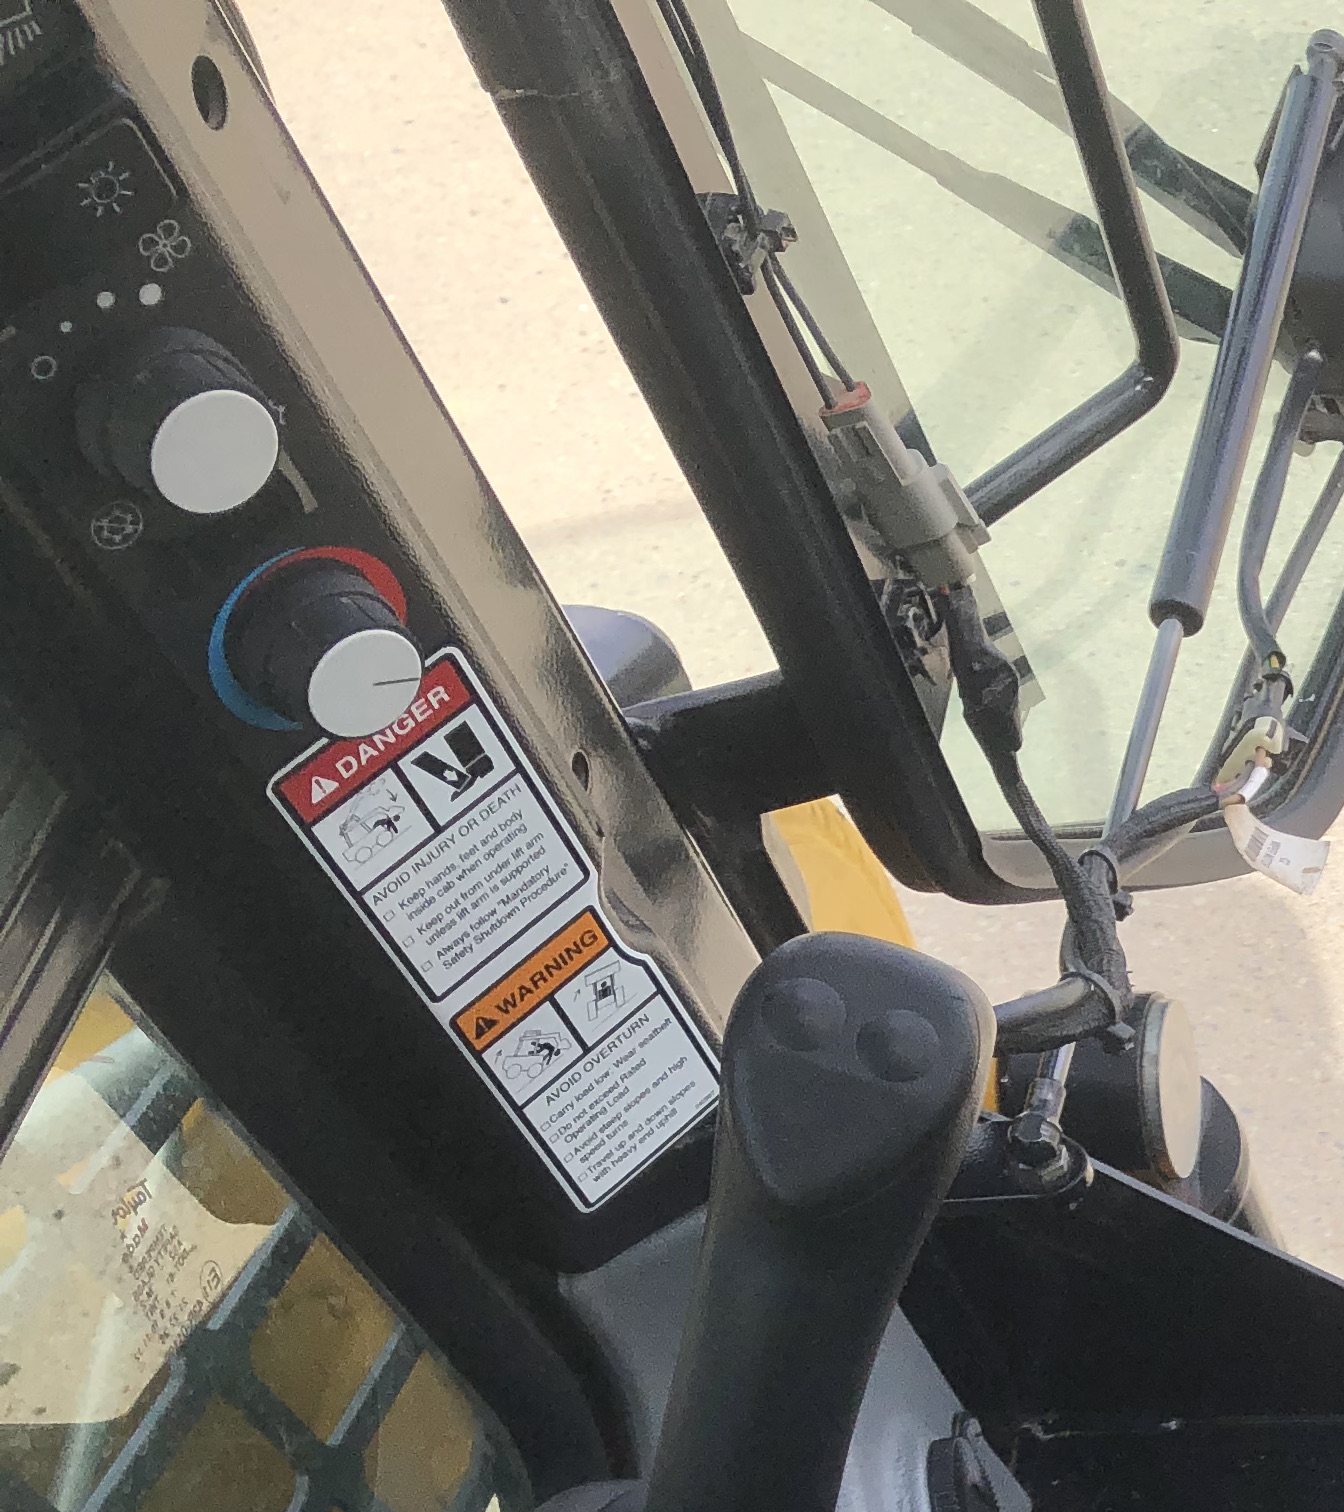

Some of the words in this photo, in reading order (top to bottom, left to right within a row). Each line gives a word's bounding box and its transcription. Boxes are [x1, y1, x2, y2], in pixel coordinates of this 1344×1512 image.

[335, 685, 451, 779] DANGER
[372, 871, 411, 907] AVOID
[411, 833, 456, 875] INJURY
[457, 817, 480, 838] OR
[478, 782, 522, 822] DEATH
[397, 887, 426, 911] Keep
[458, 843, 480, 863] feet
[479, 826, 499, 848] and
[497, 809, 523, 832] body
[405, 895, 437, 922] inside
[436, 880, 456, 898] cab
[455, 858, 483, 882] when
[482, 822, 528, 862] operating
[415, 912, 444, 936] Keep
[443, 897, 462, 915] out
[459, 880, 484, 902] from
[483, 857, 511, 884] under
[510, 846, 525, 861] lift
[525, 832, 545, 851] arm
[425, 918, 458, 946] unless
[455, 906, 471, 921] lift
[470, 891, 490, 911] arm
[488, 883, 500, 894] is
[499, 844, 547, 887] supported
[436, 930, 471, 961] Always
[469, 907, 498, 933] follow
[496, 864, 550, 907] "Mandatory
[442, 942, 474, 970] Safety
[472, 905, 521, 945] Shutdown
[493, 929, 599, 1017] WARNING
[545, 1071, 582, 1107] AVOID
[582, 1013, 650, 1073] OVERTURN
[548, 1100, 575, 1124] Carry
[573, 1082, 595, 1103] load
[612, 1047, 637, 1069] Wear
[637, 1017, 673, 1049] seatbelt
[557, 1122, 573, 1136] Do
[572, 1107, 589, 1124] not
[588, 1080, 621, 1111] exceed
[619, 1057, 647, 1084] Rated
[573, 1131, 599, 1156] Avoid
[598, 1111, 623, 1134] steep
[622, 1087, 651, 1114] slopes
[651, 1070, 669, 1089] and
[667, 1056, 688, 1074] high
[563, 1106, 609, 1144] Operating
[605, 1085, 631, 1108] Load
[579, 1137, 607, 1164] speed
[605, 1119, 629, 1141] turns
[586, 1148, 615, 1174] Travel
[614, 1140, 627, 1152] up
[627, 1123, 645, 1142] and
[644, 1104, 669, 1126] down
[667, 1080, 696, 1106] slopes
[592, 1166, 612, 1183] with
[610, 1142, 638, 1168] heavy
[638, 1126, 655, 1145] end
[655, 1107, 678, 1130] uphill
